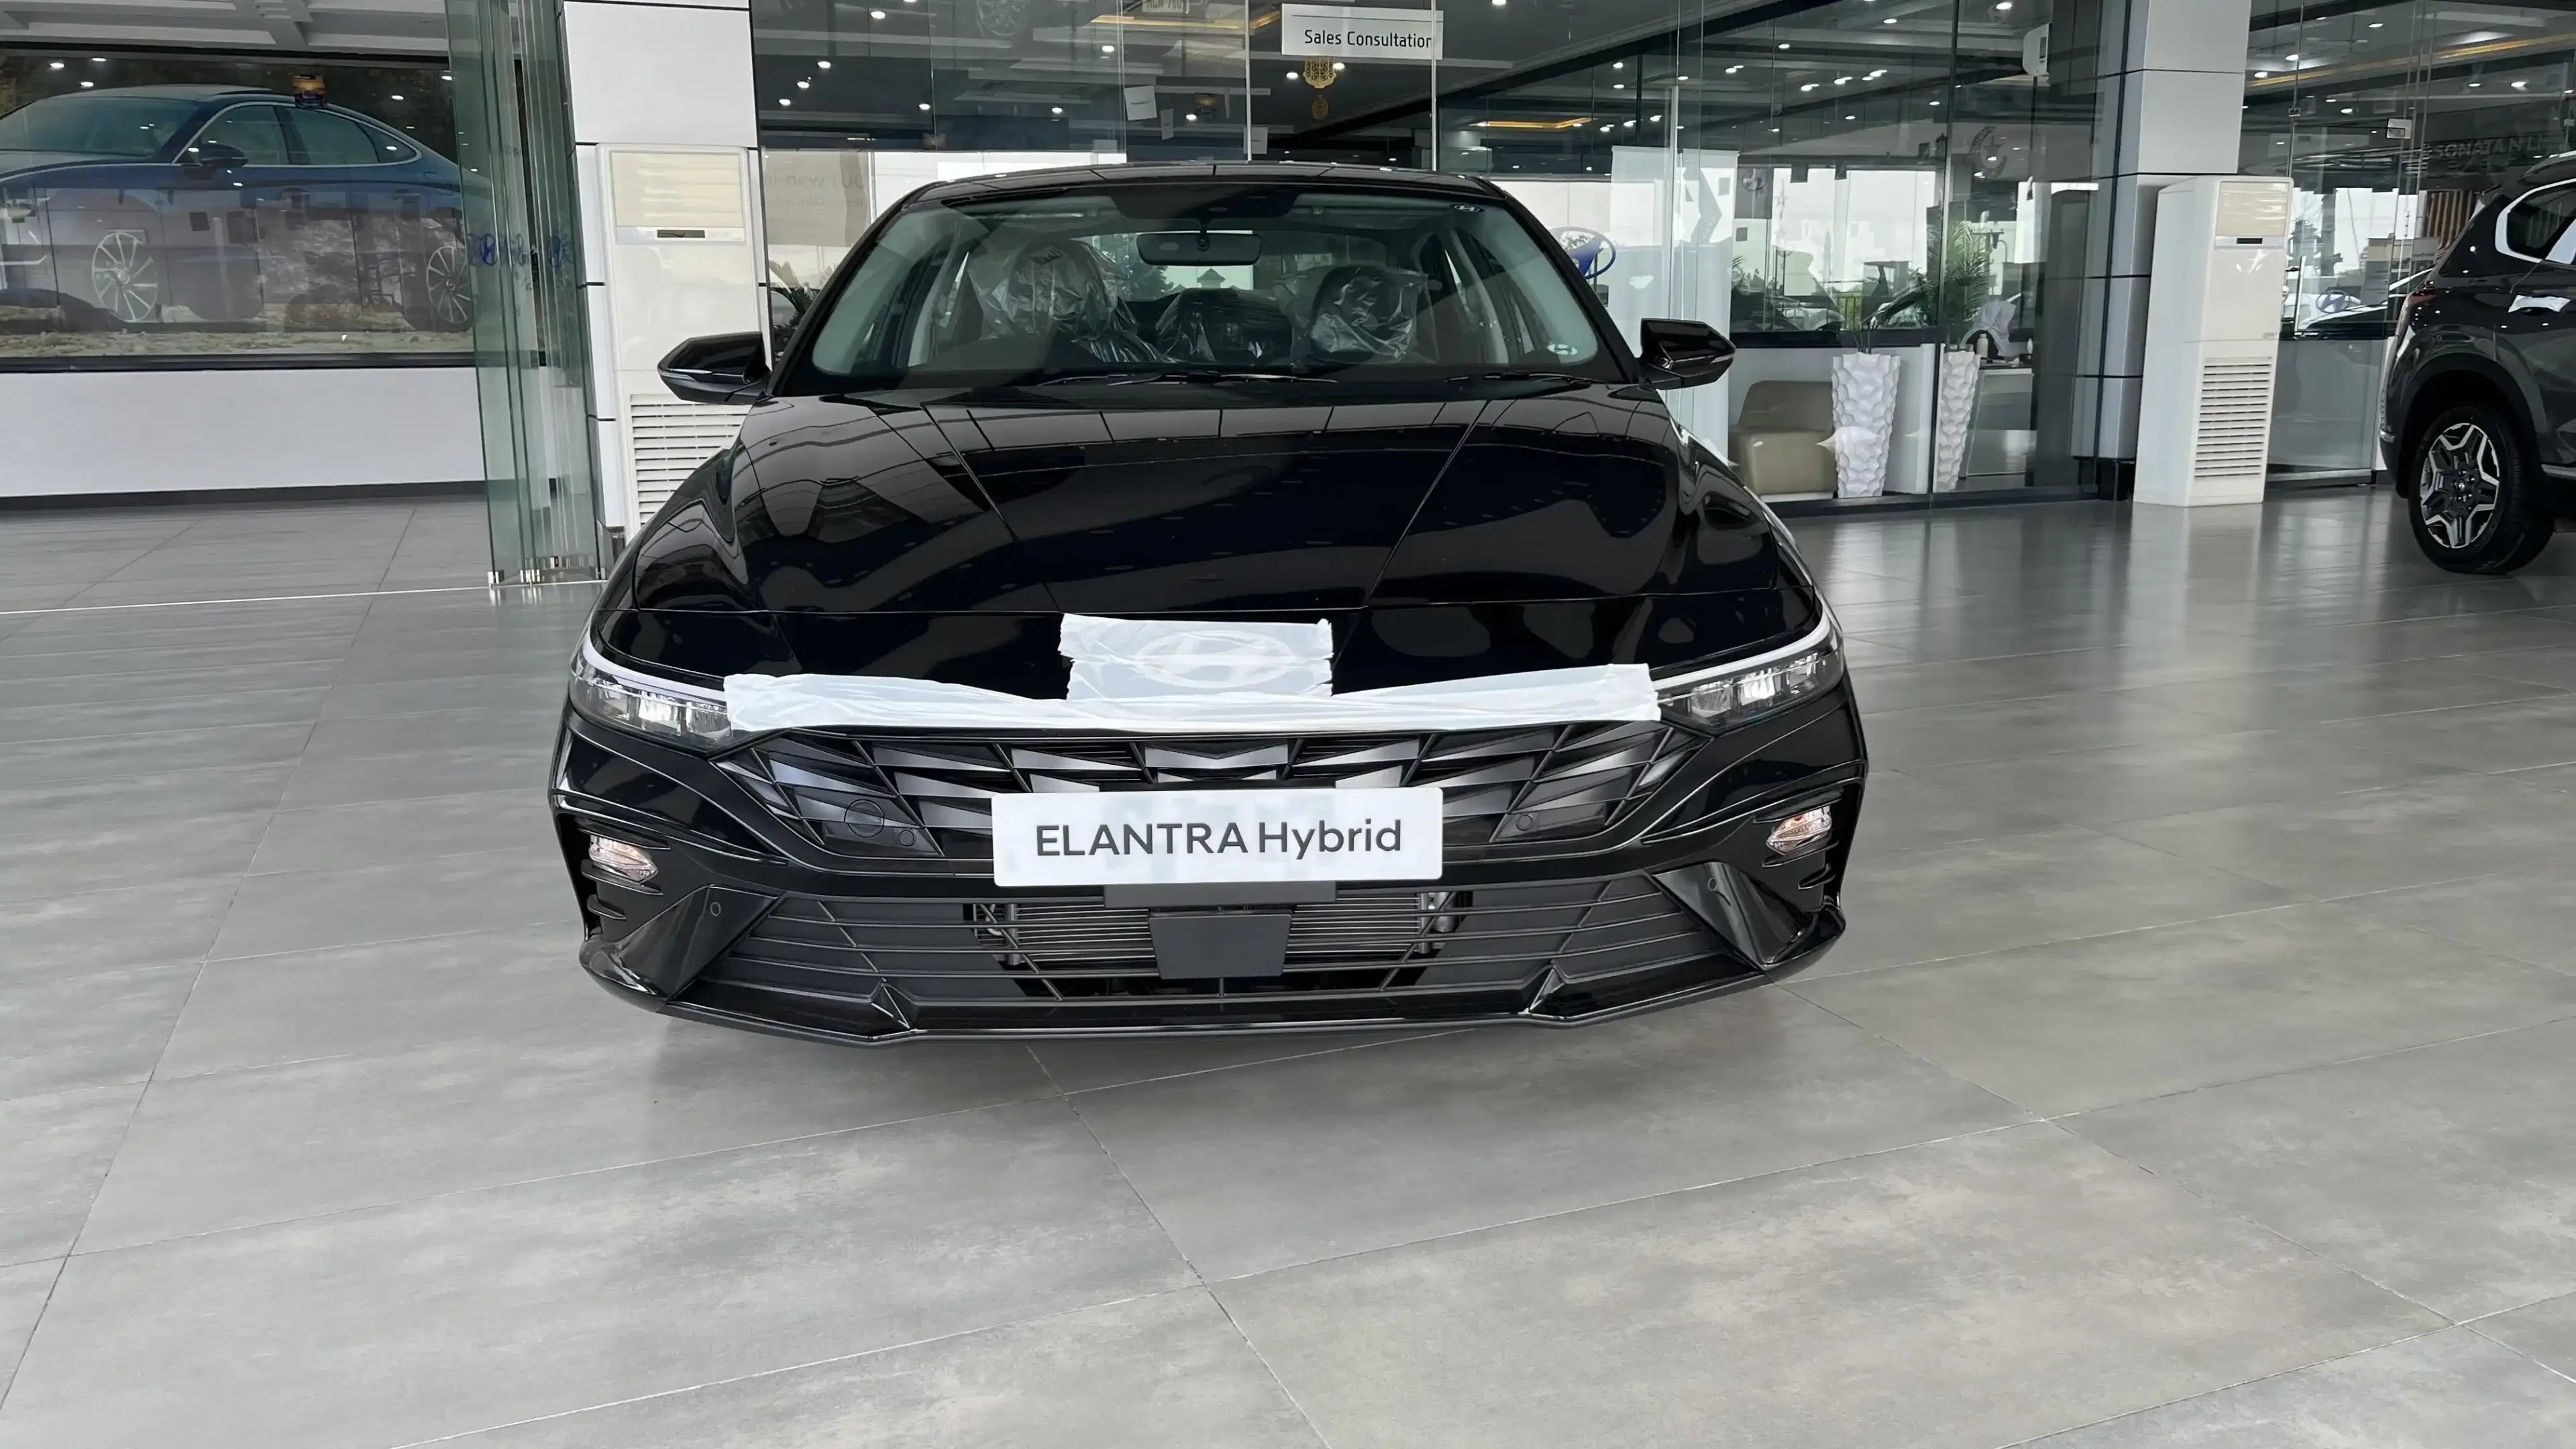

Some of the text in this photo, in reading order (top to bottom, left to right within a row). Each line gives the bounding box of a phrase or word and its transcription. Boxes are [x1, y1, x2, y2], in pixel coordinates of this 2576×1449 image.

[1304, 30, 1342, 45] Sales
[1036, 818, 1401, 860] ELANTRA Hybrid
